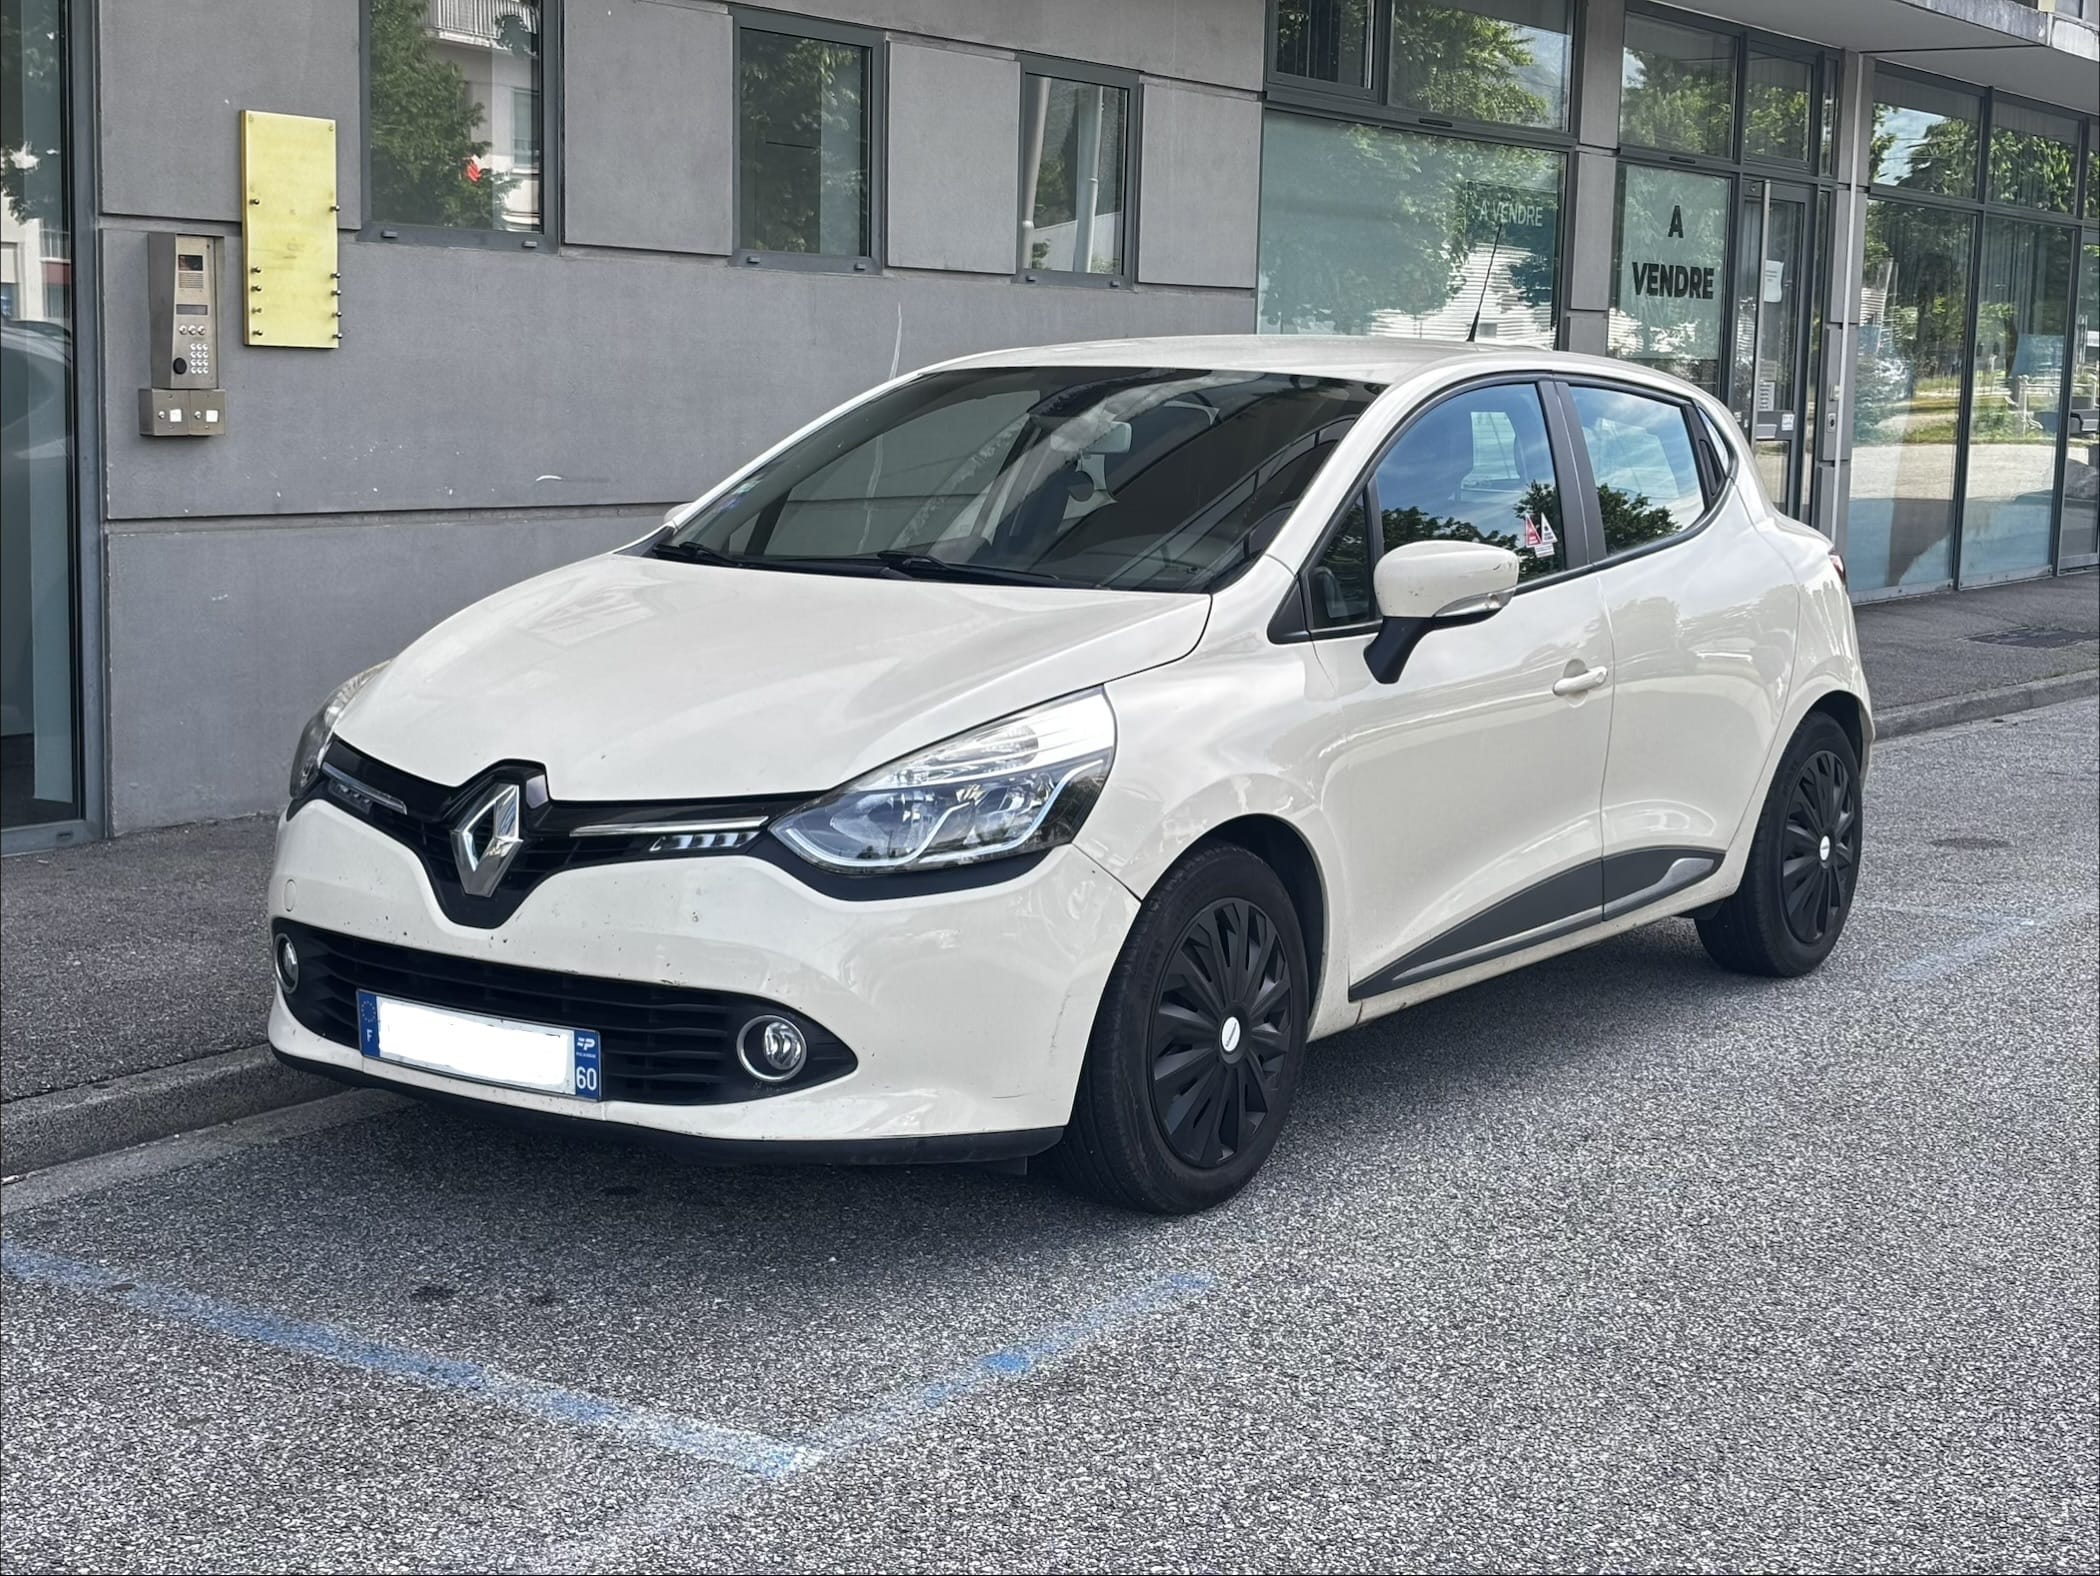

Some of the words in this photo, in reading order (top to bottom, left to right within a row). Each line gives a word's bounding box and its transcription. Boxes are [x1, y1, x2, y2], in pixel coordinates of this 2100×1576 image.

[1493, 200, 1543, 227] VENDRE
[1667, 205, 1684, 239] A
[1631, 262, 1715, 300] VENDRE
[366, 1029, 373, 1042] F
[576, 1066, 597, 1091] 60
